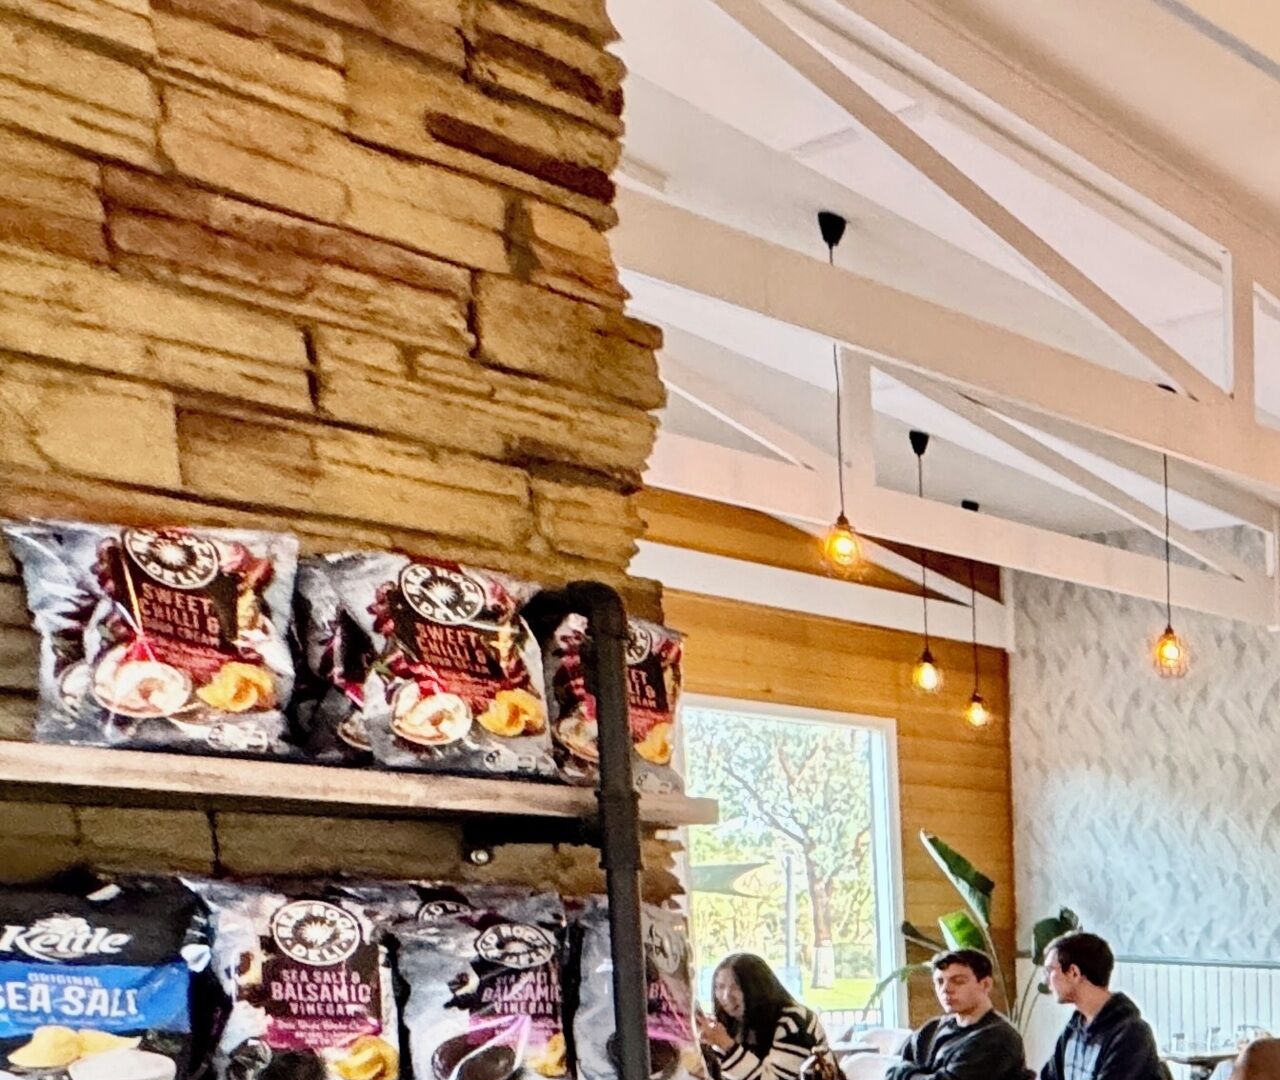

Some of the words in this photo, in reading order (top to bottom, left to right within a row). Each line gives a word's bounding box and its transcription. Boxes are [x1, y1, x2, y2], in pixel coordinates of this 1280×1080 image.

[141, 582, 214, 615] SWEET
[139, 598, 201, 631] CHILLI
[415, 621, 481, 649] SWEET
[415, 636, 471, 662] CHILLI
[0, 917, 132, 962] Kettle
[290, 942, 345, 962] DELI
[27, 972, 103, 988] ORIGINAL
[282, 968, 310, 983] SEA
[312, 966, 347, 985] SALT
[61, 985, 139, 1018] SALT
[270, 980, 372, 1003] BALSAMIC
[495, 1002, 554, 1016] VINEGAR
